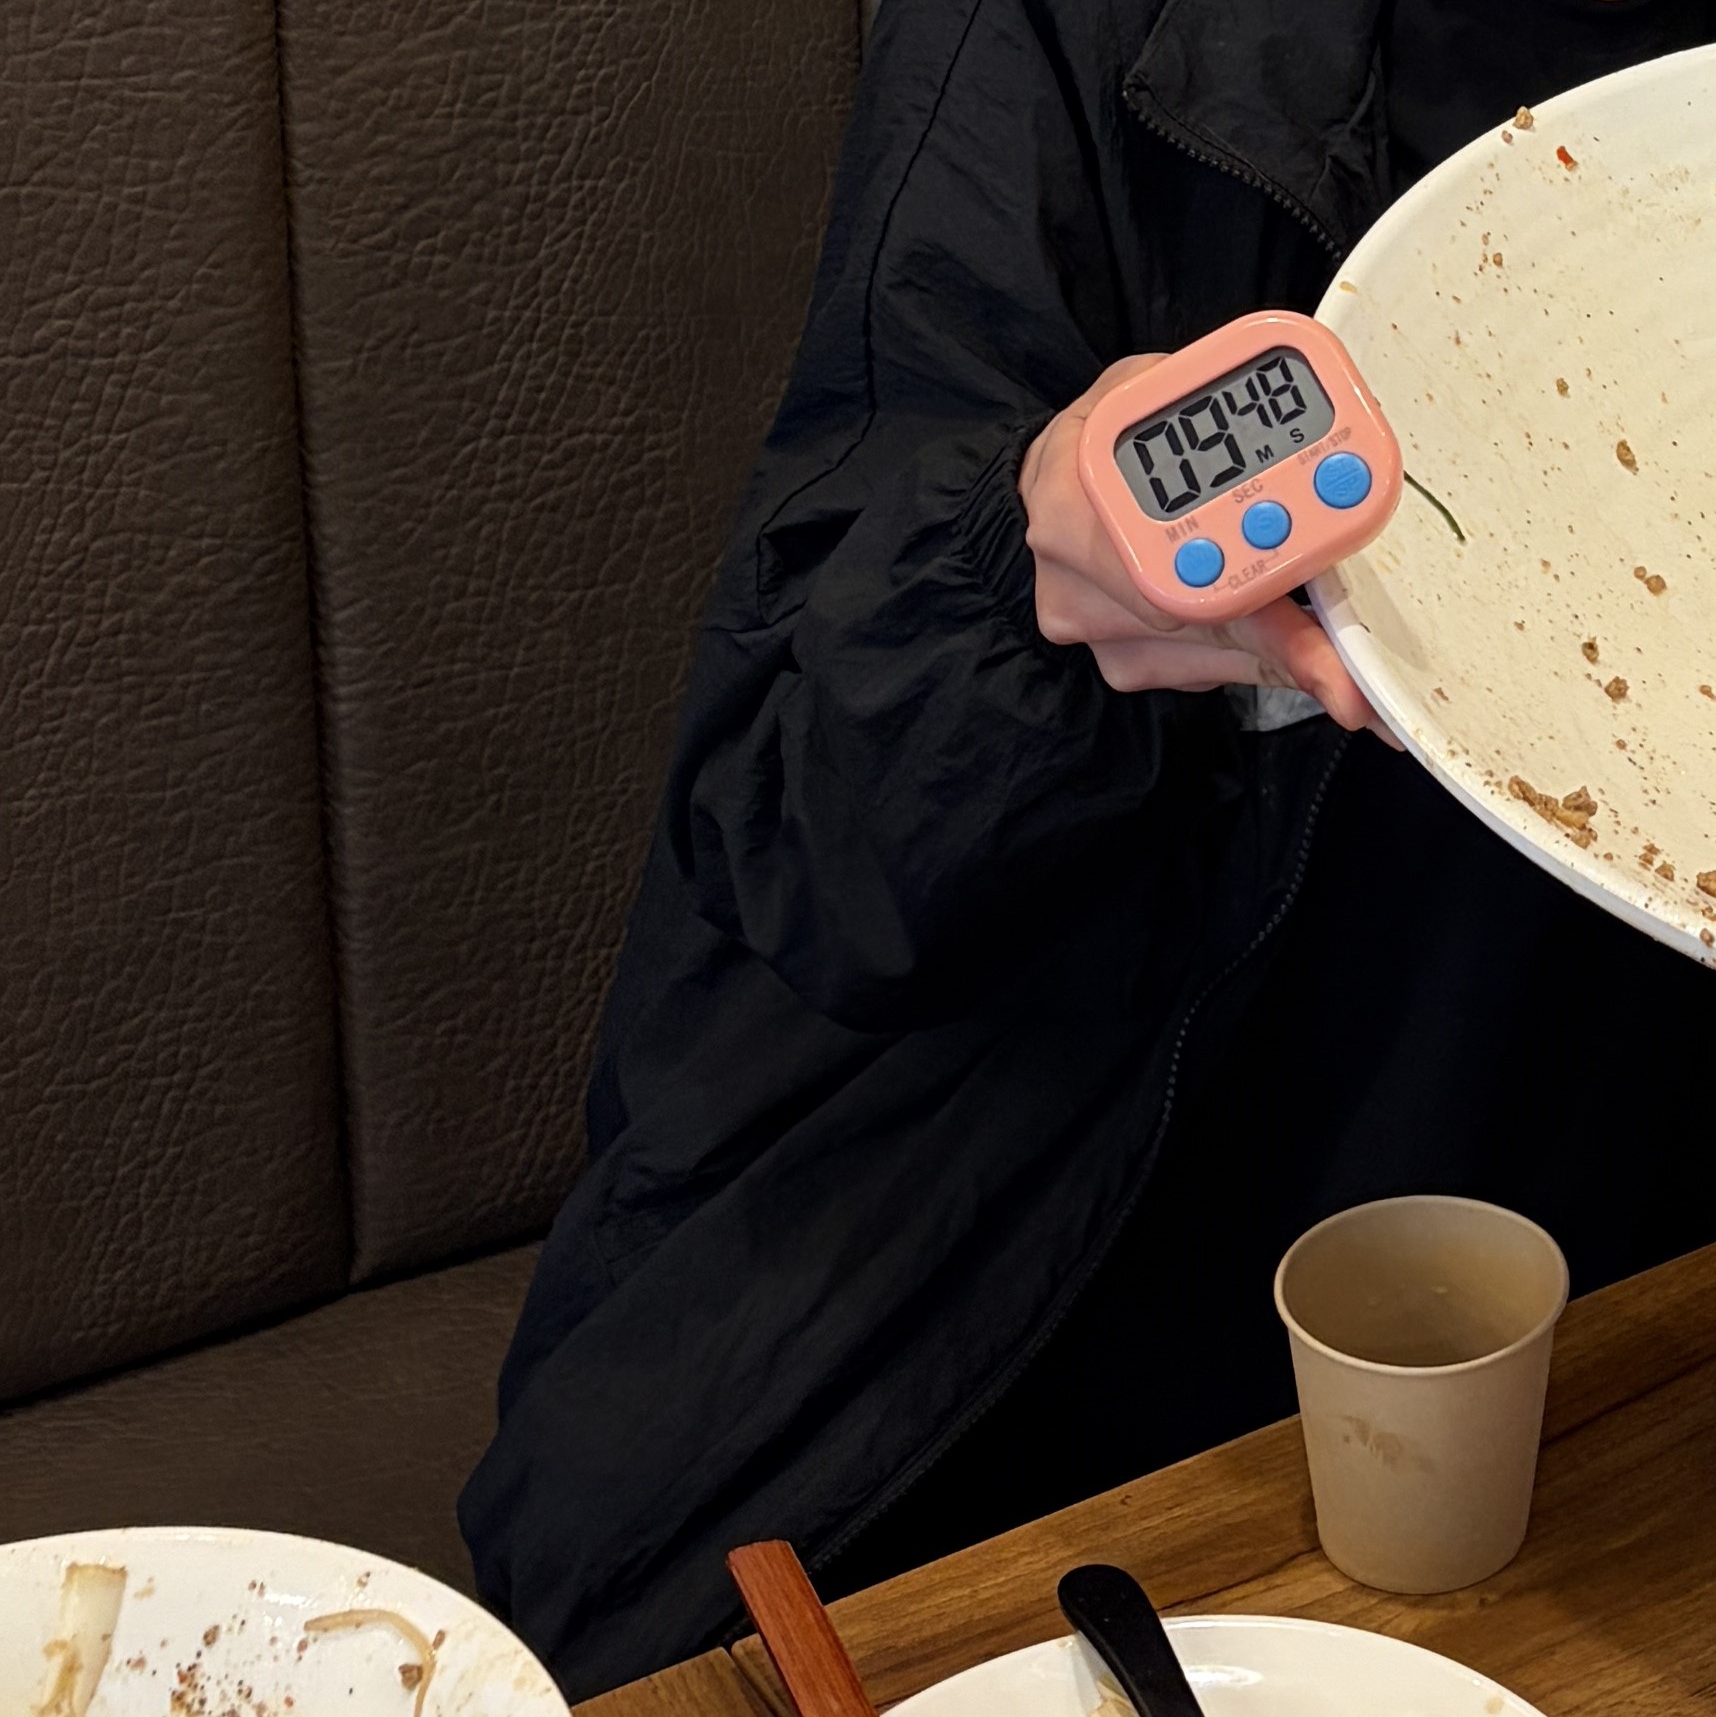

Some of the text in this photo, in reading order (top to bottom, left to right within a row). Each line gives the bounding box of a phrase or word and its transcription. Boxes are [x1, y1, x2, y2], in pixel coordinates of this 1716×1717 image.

[1256, 428, 1305, 464] M S
[1165, 426, 1352, 543] MIN SEC START/STOP
[1228, 559, 1268, 589] CLEAR
